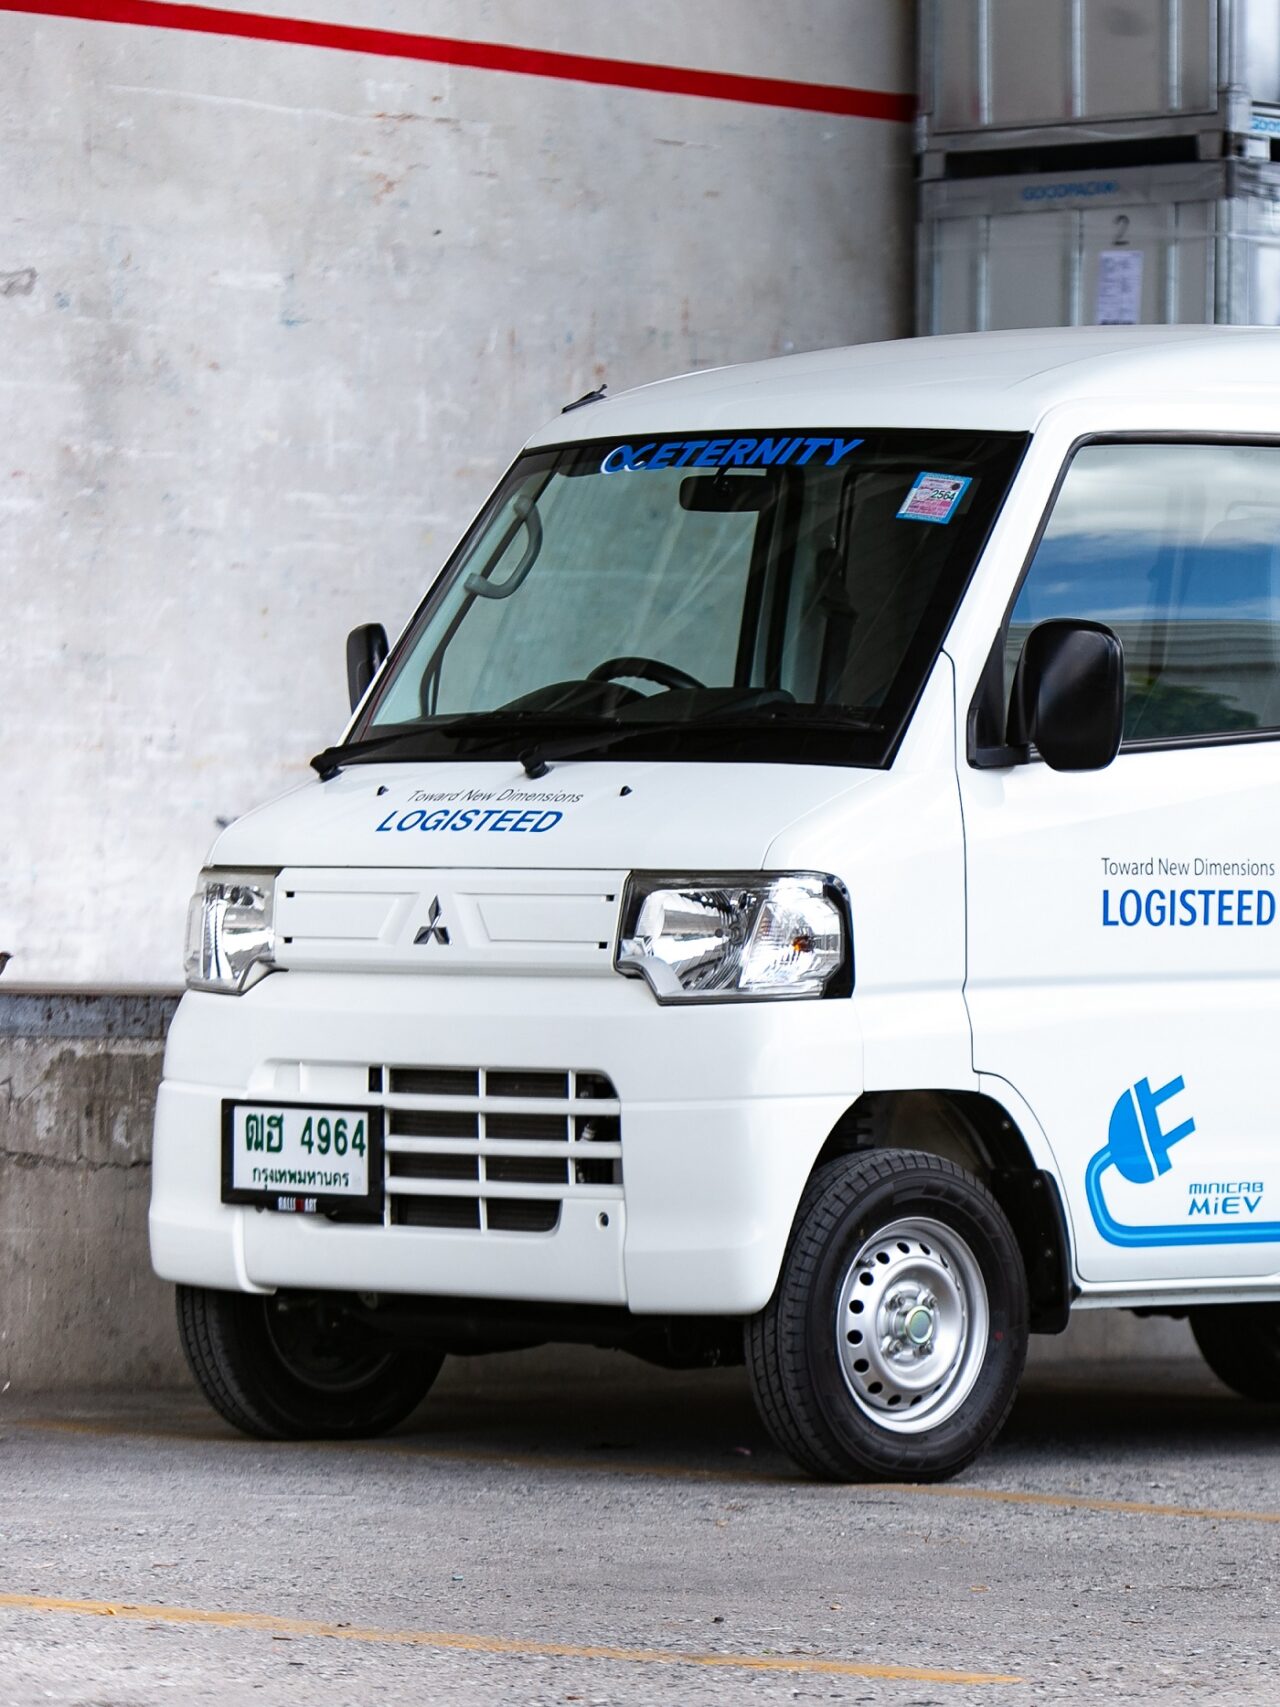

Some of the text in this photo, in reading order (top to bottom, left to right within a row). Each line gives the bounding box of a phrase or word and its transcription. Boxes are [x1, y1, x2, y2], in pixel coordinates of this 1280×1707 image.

[1115, 215, 1130, 244] 2
[931, 489, 957, 501] 2564
[408, 788, 584, 803] Toward New Dimensions
[375, 809, 563, 833] LOGISTEED
[1101, 857, 1275, 876] Toward New Dimensions
[1102, 889, 1276, 926] LOGISTEED
[300, 1115, 366, 1158] 4964
[252, 1167, 350, 1192] กรุงเทพมหานคร
[1188, 1182, 1264, 1194] MINICAB
[1188, 1196, 1263, 1216] MiEV
